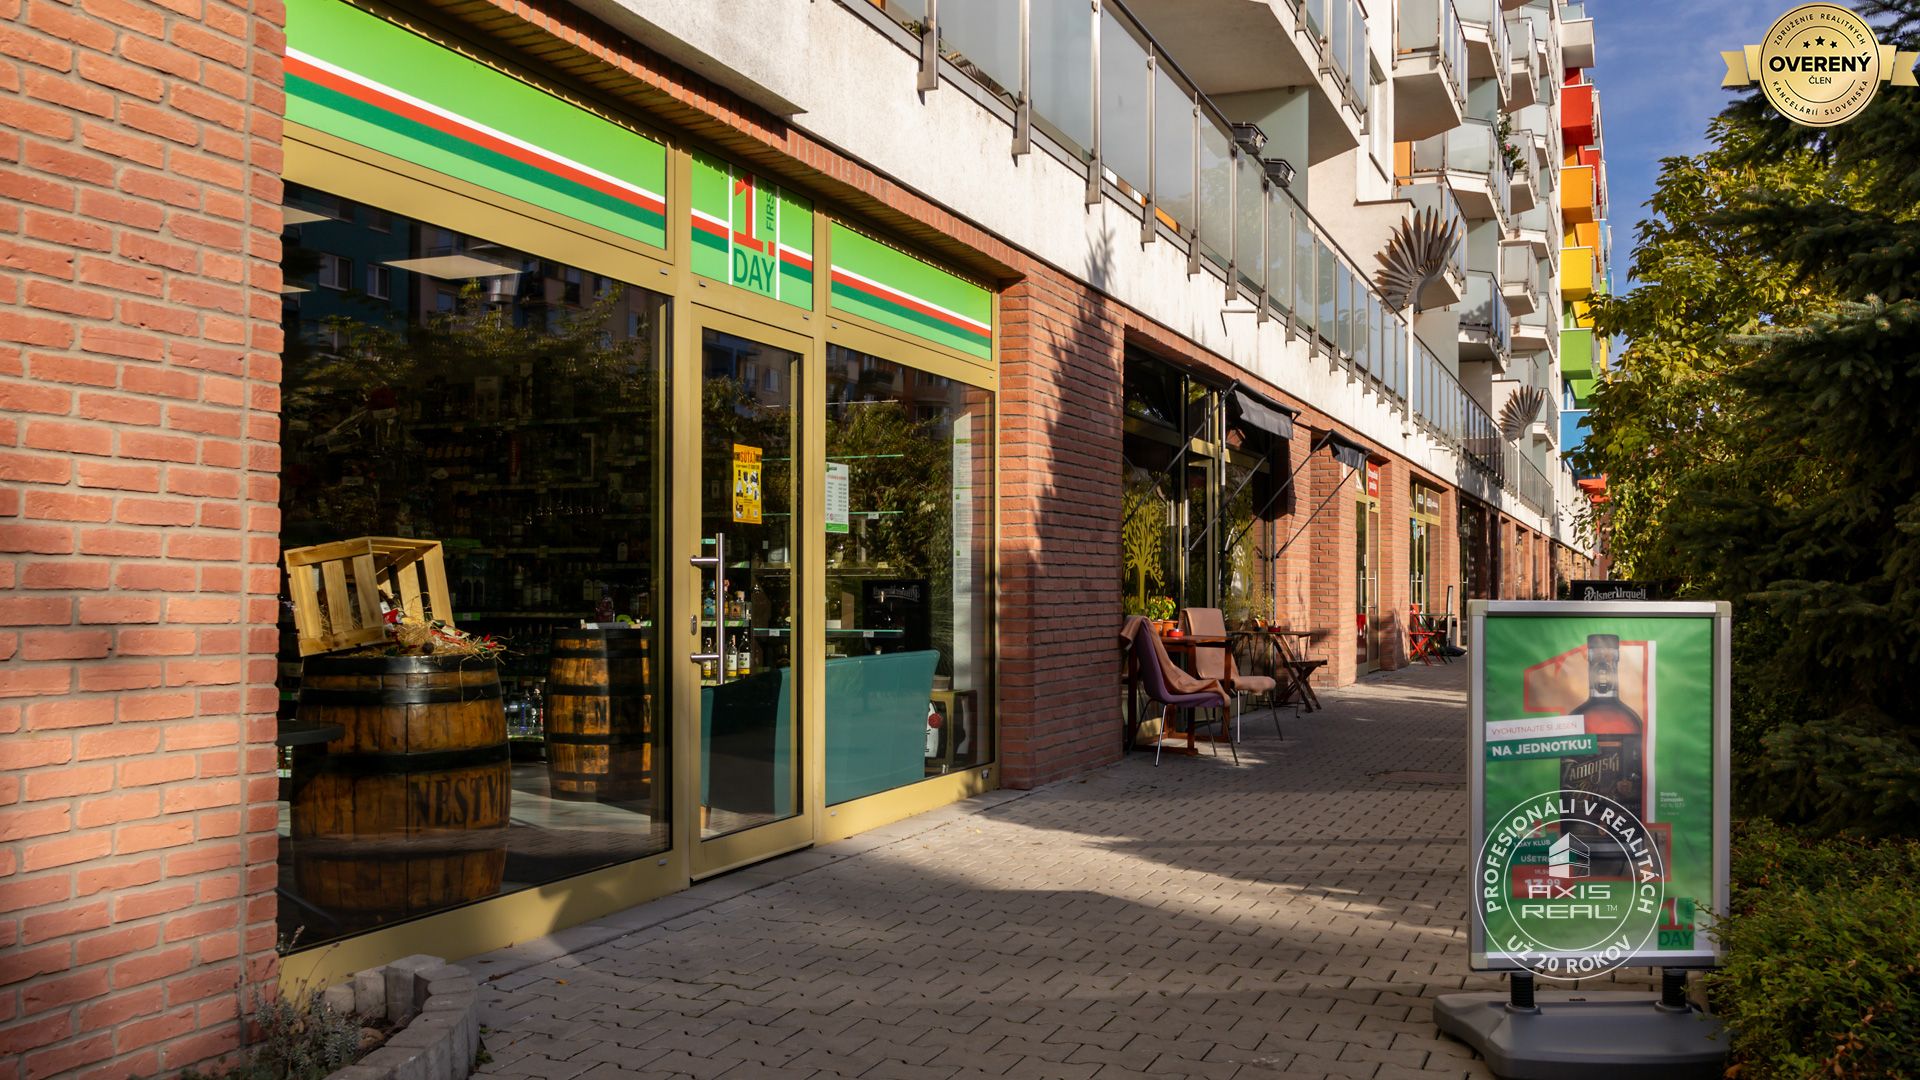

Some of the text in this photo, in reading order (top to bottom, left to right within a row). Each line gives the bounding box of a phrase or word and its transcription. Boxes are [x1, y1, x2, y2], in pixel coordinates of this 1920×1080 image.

[733, 248, 775, 293] DAY
[1584, 585, 1646, 601] Pilsner Urquell
[1492, 724, 1544, 736] VYCHUTNAJTE
[1492, 739, 1592, 757] NA JEDNOTKU!
[1659, 931, 1693, 946] DAY
